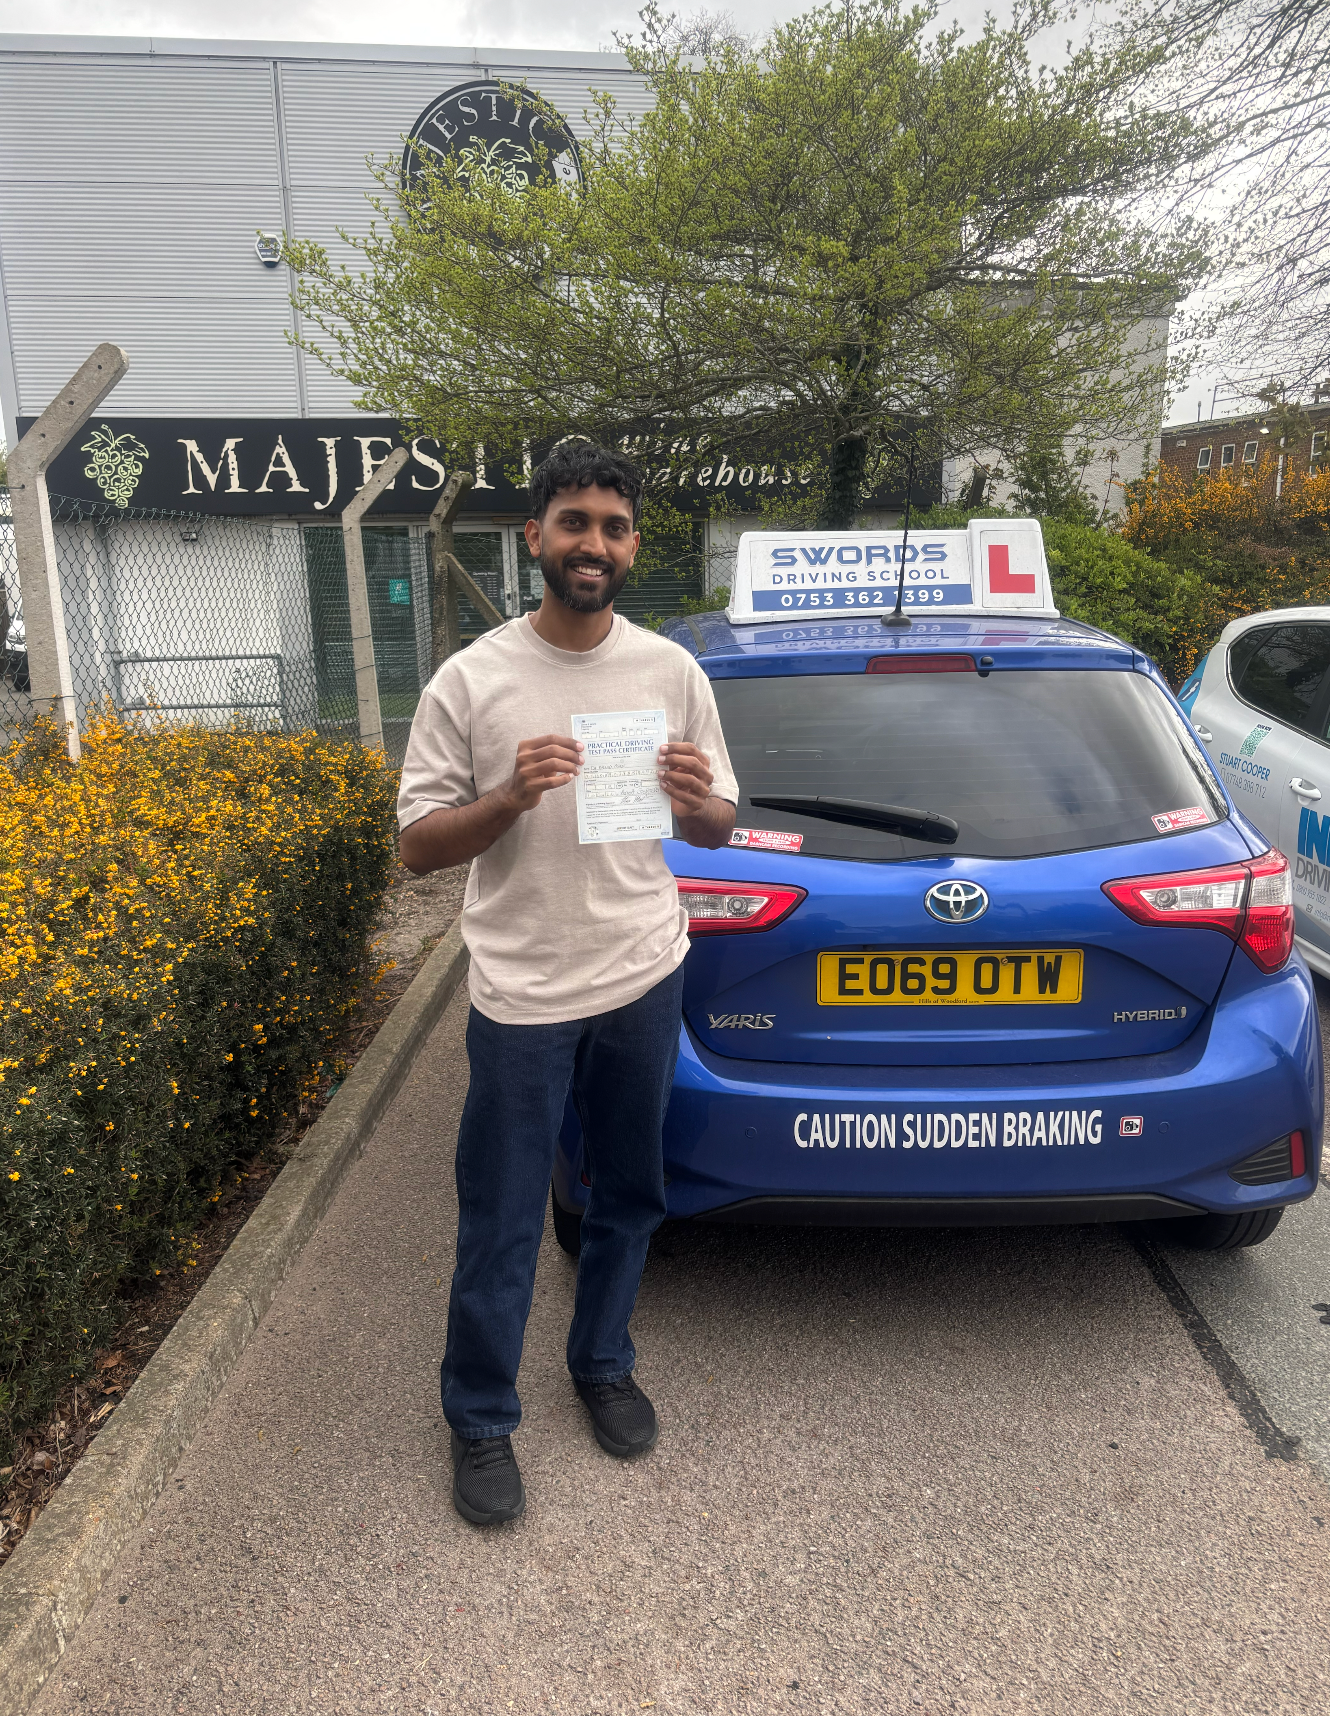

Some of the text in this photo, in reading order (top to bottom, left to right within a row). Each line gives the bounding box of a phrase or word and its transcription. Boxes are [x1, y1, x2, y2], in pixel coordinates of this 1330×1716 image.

[771, 543, 948, 568] SWORDS
[772, 568, 950, 585] DRIVING SCHOOL
[988, 545, 1035, 593] L
[781, 593, 834, 607] 0753
[844, 591, 884, 605] 362
[587, 739, 654, 749] PRACTICAL DRIVING
[1219, 752, 1271, 781] STUART COOPER
[1169, 808, 1203, 820] WARNING
[752, 831, 800, 843] WARNING
[838, 954, 1063, 997] EO69 OTW
[1113, 1009, 1177, 1023] HYBRID
[794, 1110, 1102, 1149] CAUTION SUDDEN BRAKING
